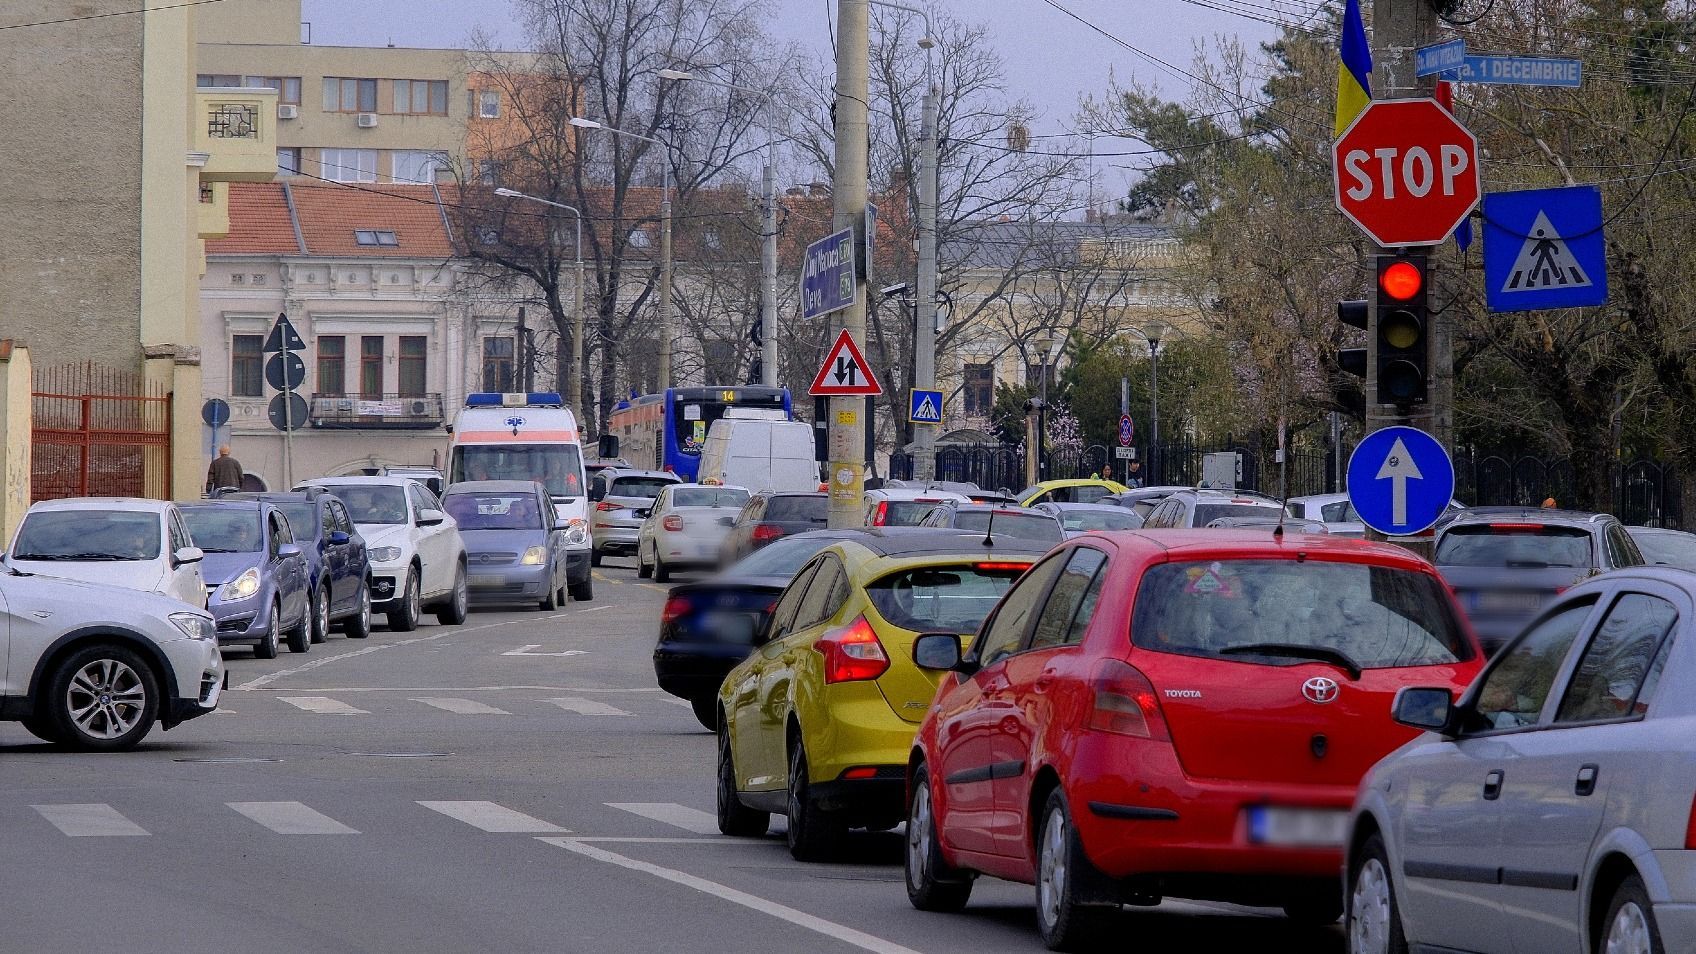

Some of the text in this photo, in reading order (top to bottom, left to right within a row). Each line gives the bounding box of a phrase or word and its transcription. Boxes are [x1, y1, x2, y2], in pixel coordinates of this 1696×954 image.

[1480, 62, 1487, 77] 1
[1492, 60, 1578, 81] DECEMBRIE
[1344, 144, 1469, 201] STOP
[805, 288, 822, 312] Deva
[723, 391, 733, 401] 14
[1165, 690, 1202, 698] TOYOTA
